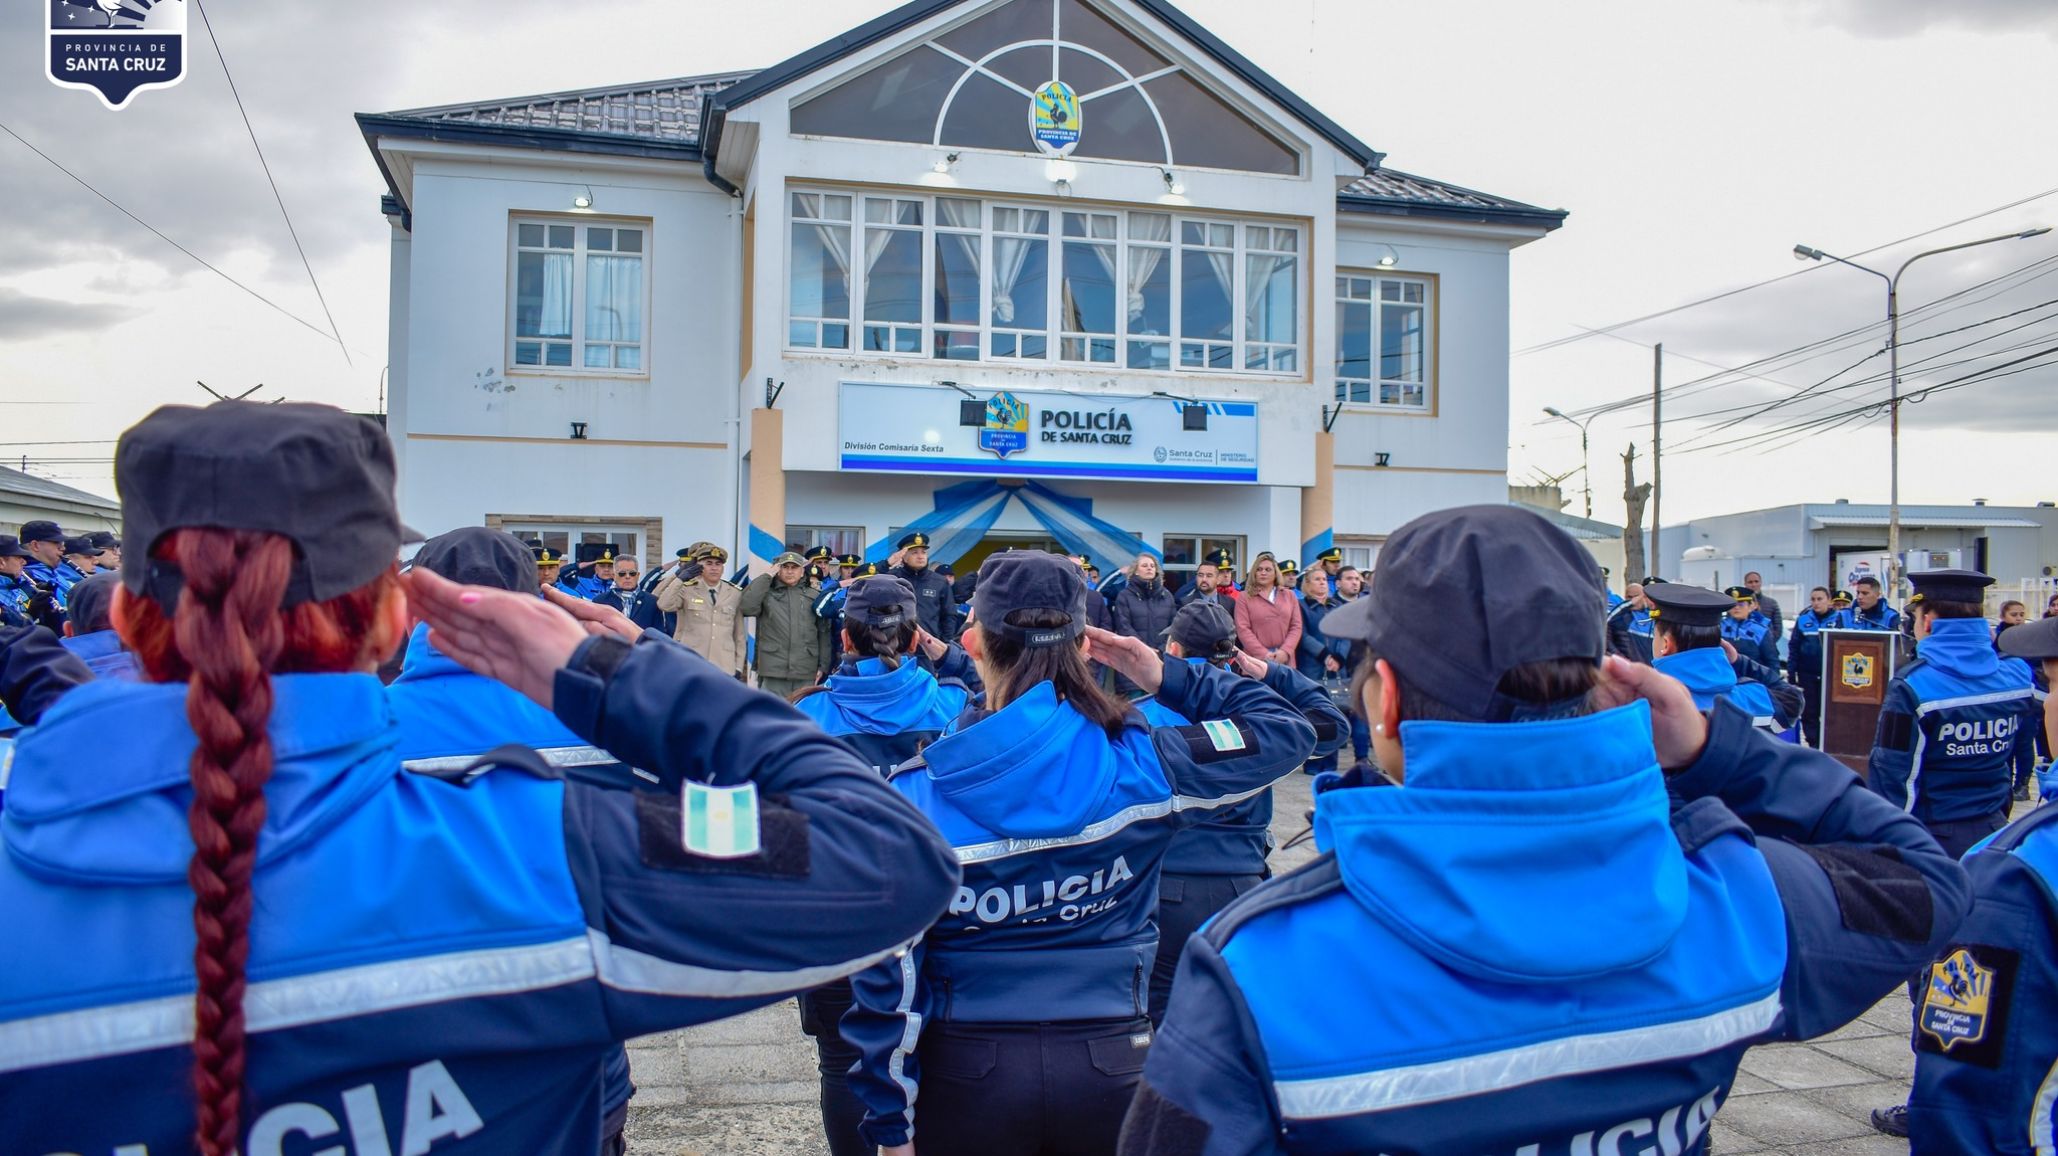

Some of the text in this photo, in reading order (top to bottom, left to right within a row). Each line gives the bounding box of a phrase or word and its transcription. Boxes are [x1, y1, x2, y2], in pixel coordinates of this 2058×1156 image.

[1041, 408, 1132, 431] POLICÍA
[1041, 431, 1132, 445] DE SANTA CRUZ
[844, 441, 877, 451] División
[920, 444, 944, 453] Sexta
[1169, 449, 1213, 458] Santa Cruz
[1938, 714, 2019, 741] POLICIA
[1946, 741, 1989, 756] Santa
[949, 855, 1134, 923] POLICIA
